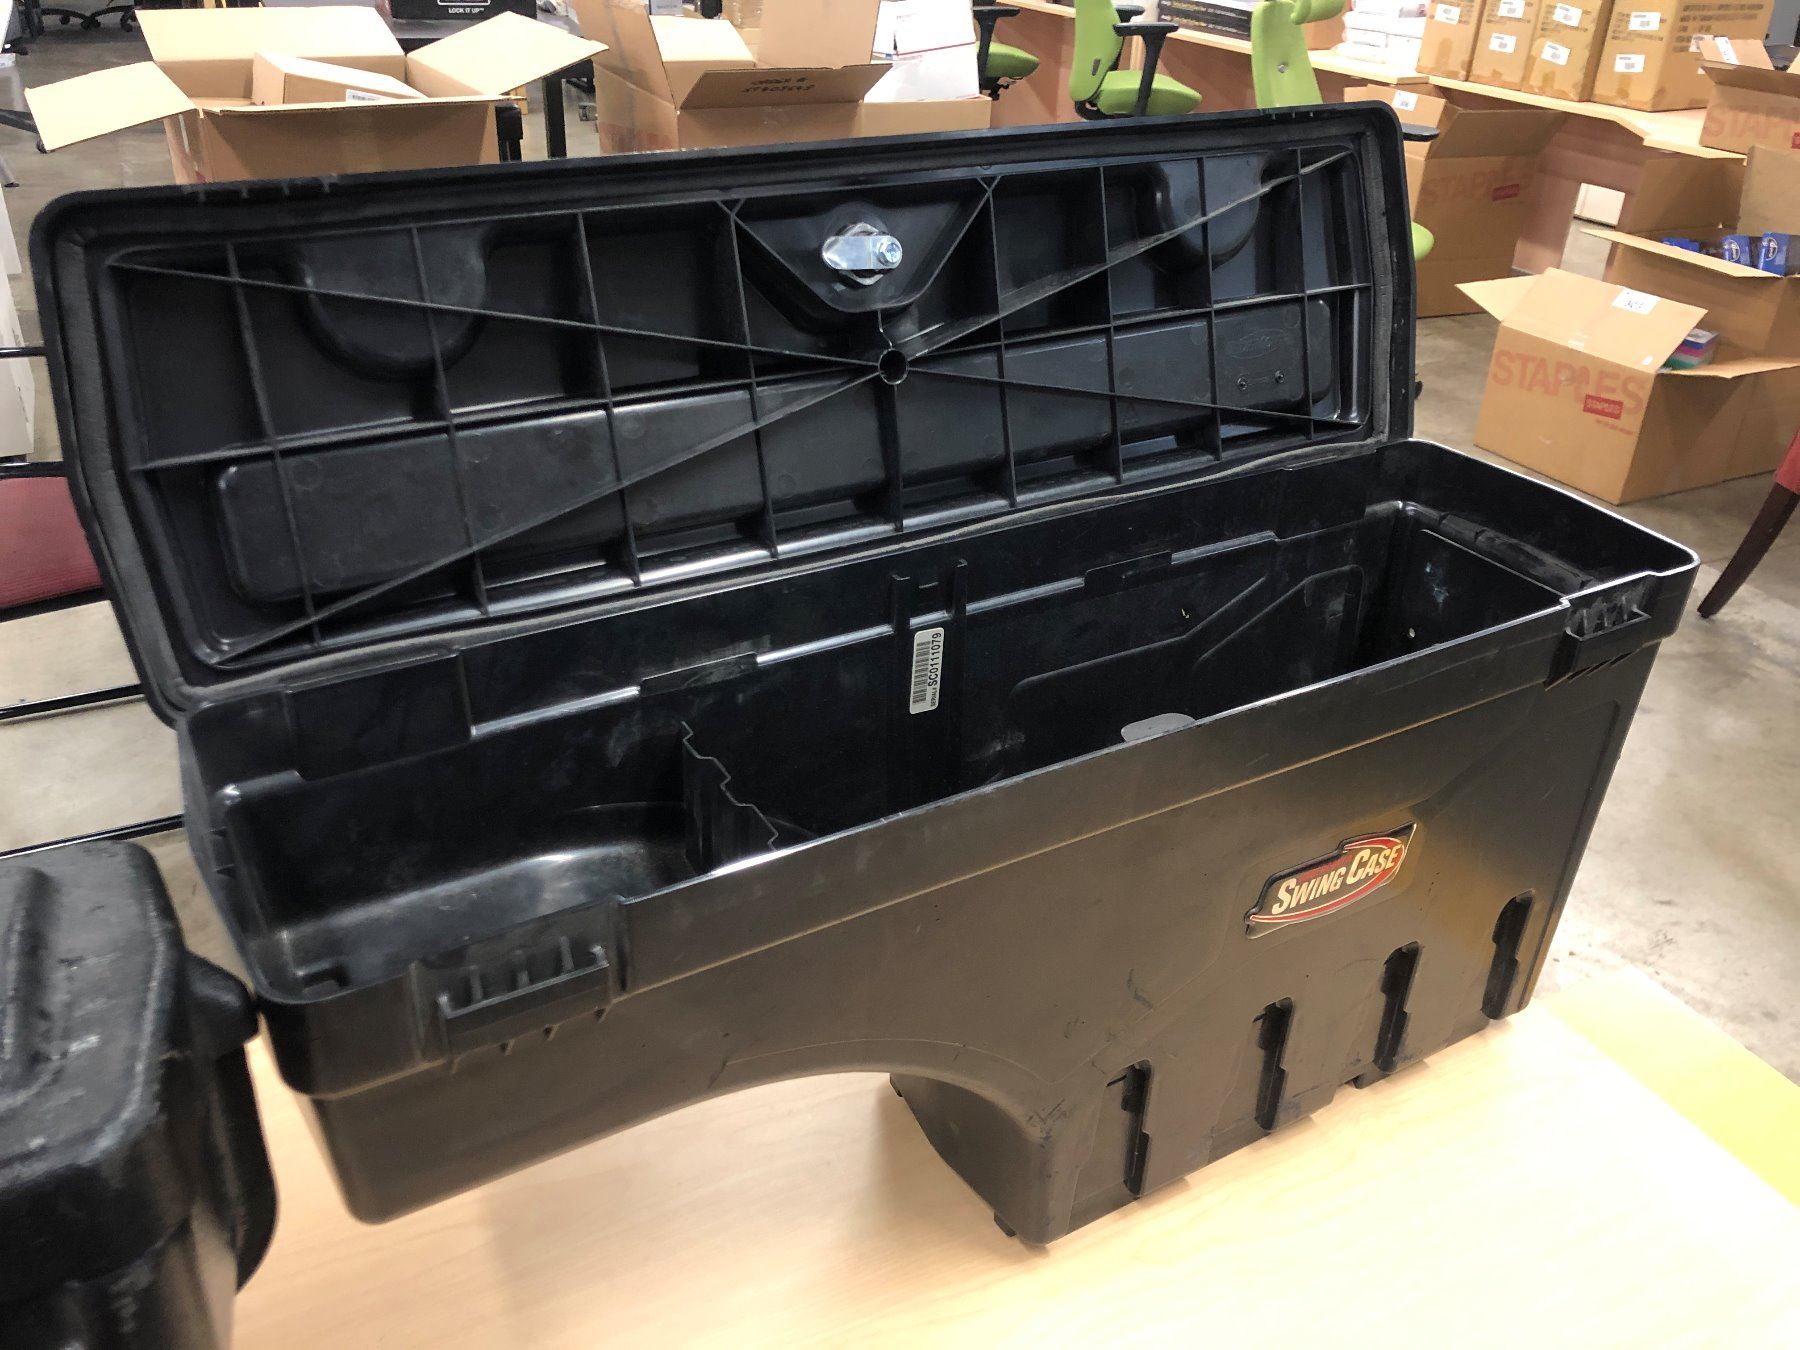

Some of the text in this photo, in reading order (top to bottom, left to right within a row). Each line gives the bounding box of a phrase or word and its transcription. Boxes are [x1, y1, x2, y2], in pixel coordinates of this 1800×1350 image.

[1492, 349, 1647, 415] STAPLES
[927, 632, 942, 688] SC0111079
[1271, 844, 1403, 915] SWING CASE
